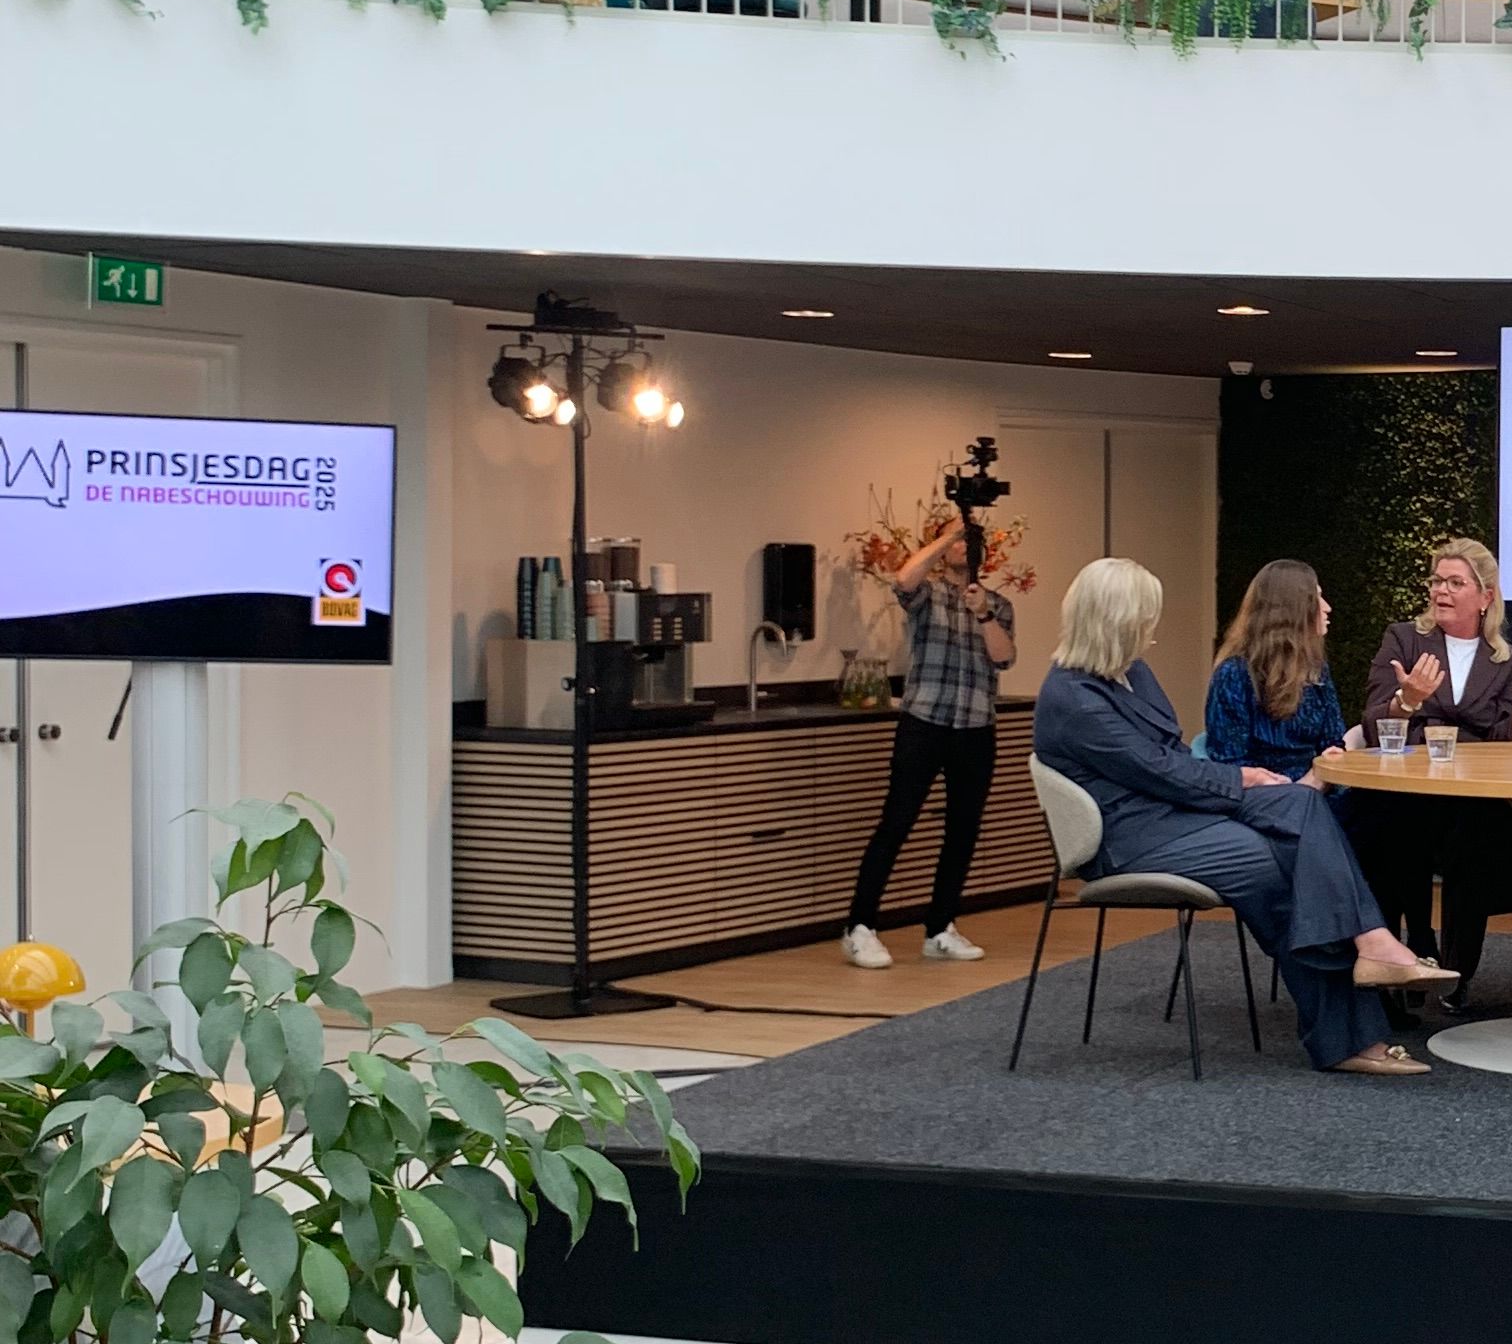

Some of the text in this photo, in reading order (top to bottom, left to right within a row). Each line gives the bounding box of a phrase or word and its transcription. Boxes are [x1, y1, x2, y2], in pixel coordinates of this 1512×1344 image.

[85, 449, 311, 483] PRINSJESDAG
[85, 484, 311, 508] DE NABESCHOUWING
[314, 457, 337, 512] 2025
